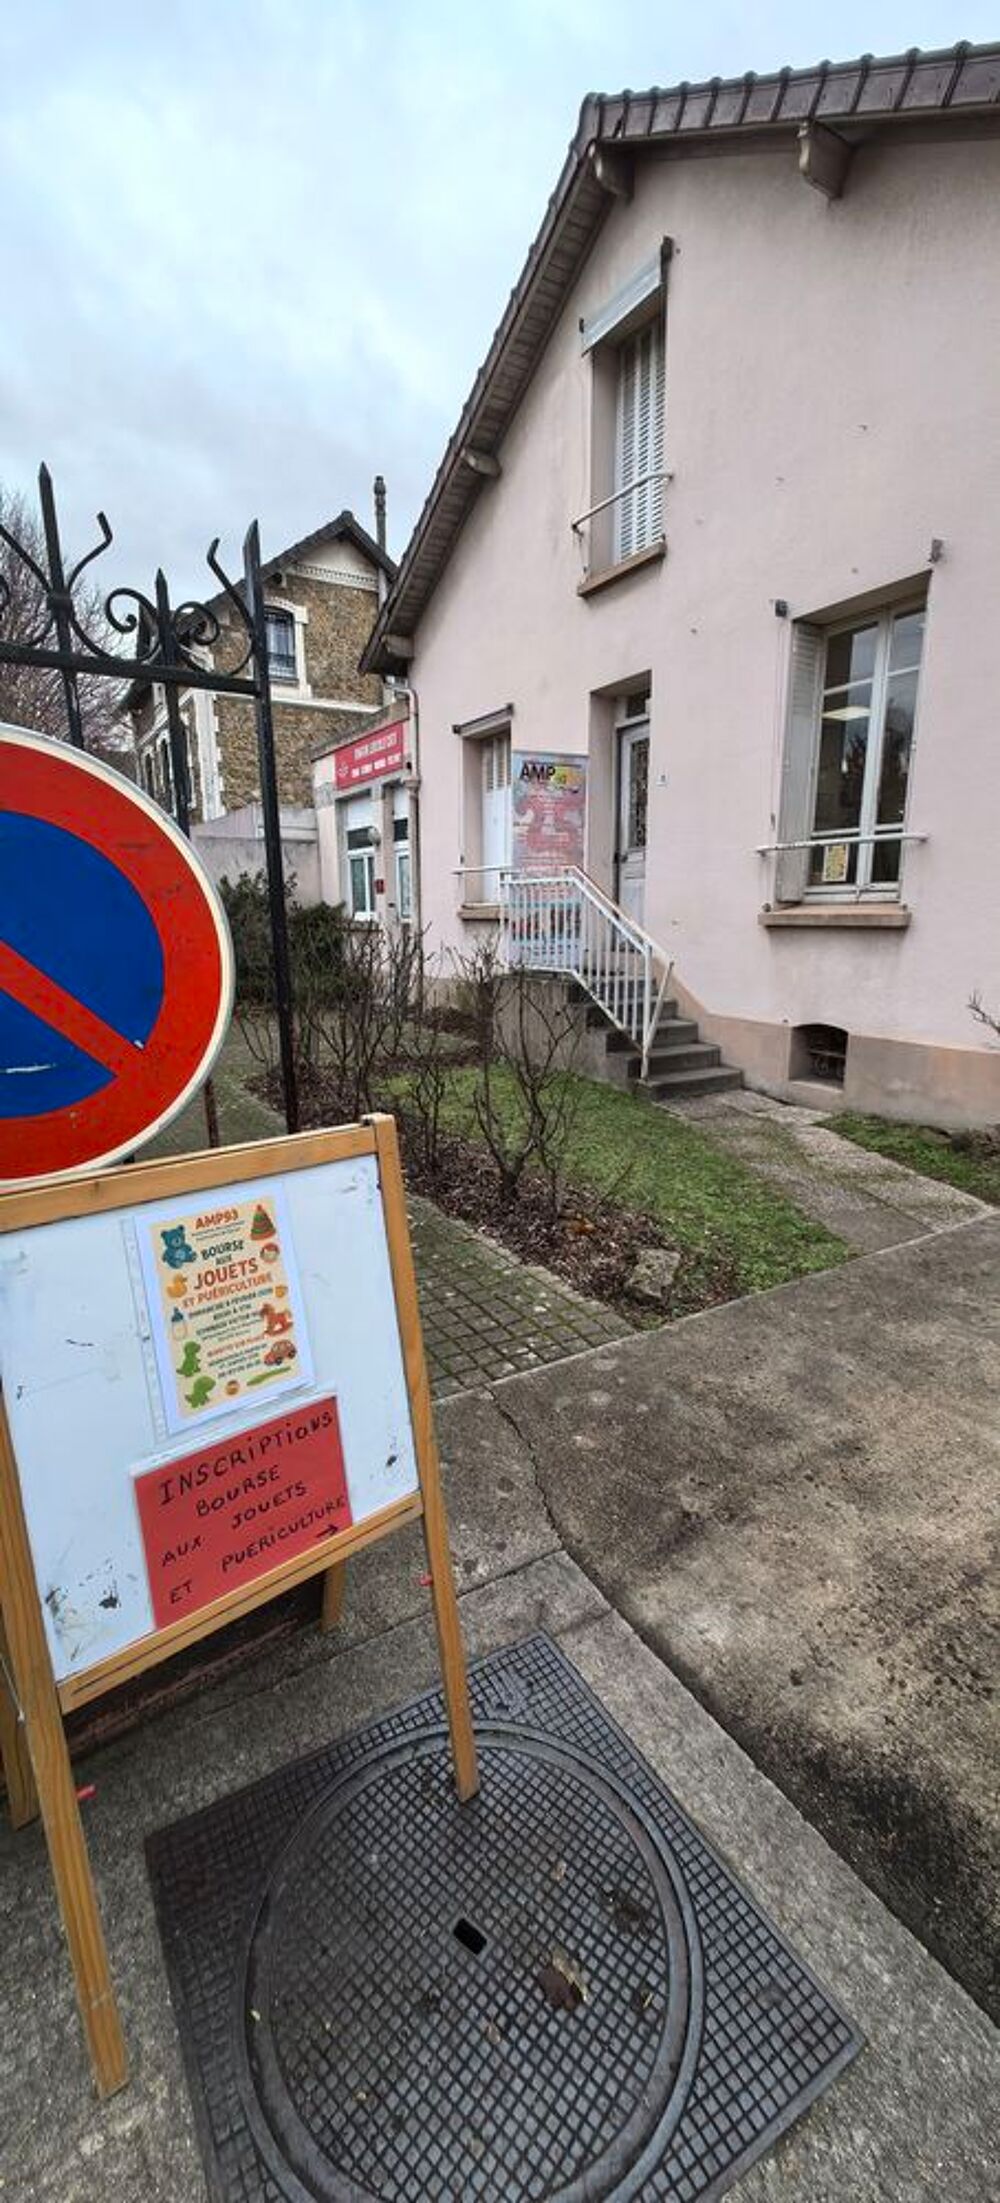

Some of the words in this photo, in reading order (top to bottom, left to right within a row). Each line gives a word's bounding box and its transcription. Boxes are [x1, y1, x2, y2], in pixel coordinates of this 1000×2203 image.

[195, 1208, 239, 1230] AMP93
[201, 1239, 244, 1260] BOURSE
[194, 1257, 258, 1289] JOUETS
[195, 1465, 281, 1516] BOURSE
[162, 1535, 203, 1566] AUX
[232, 1480, 307, 1529] JOUETS
[170, 1580, 193, 1604] ET
